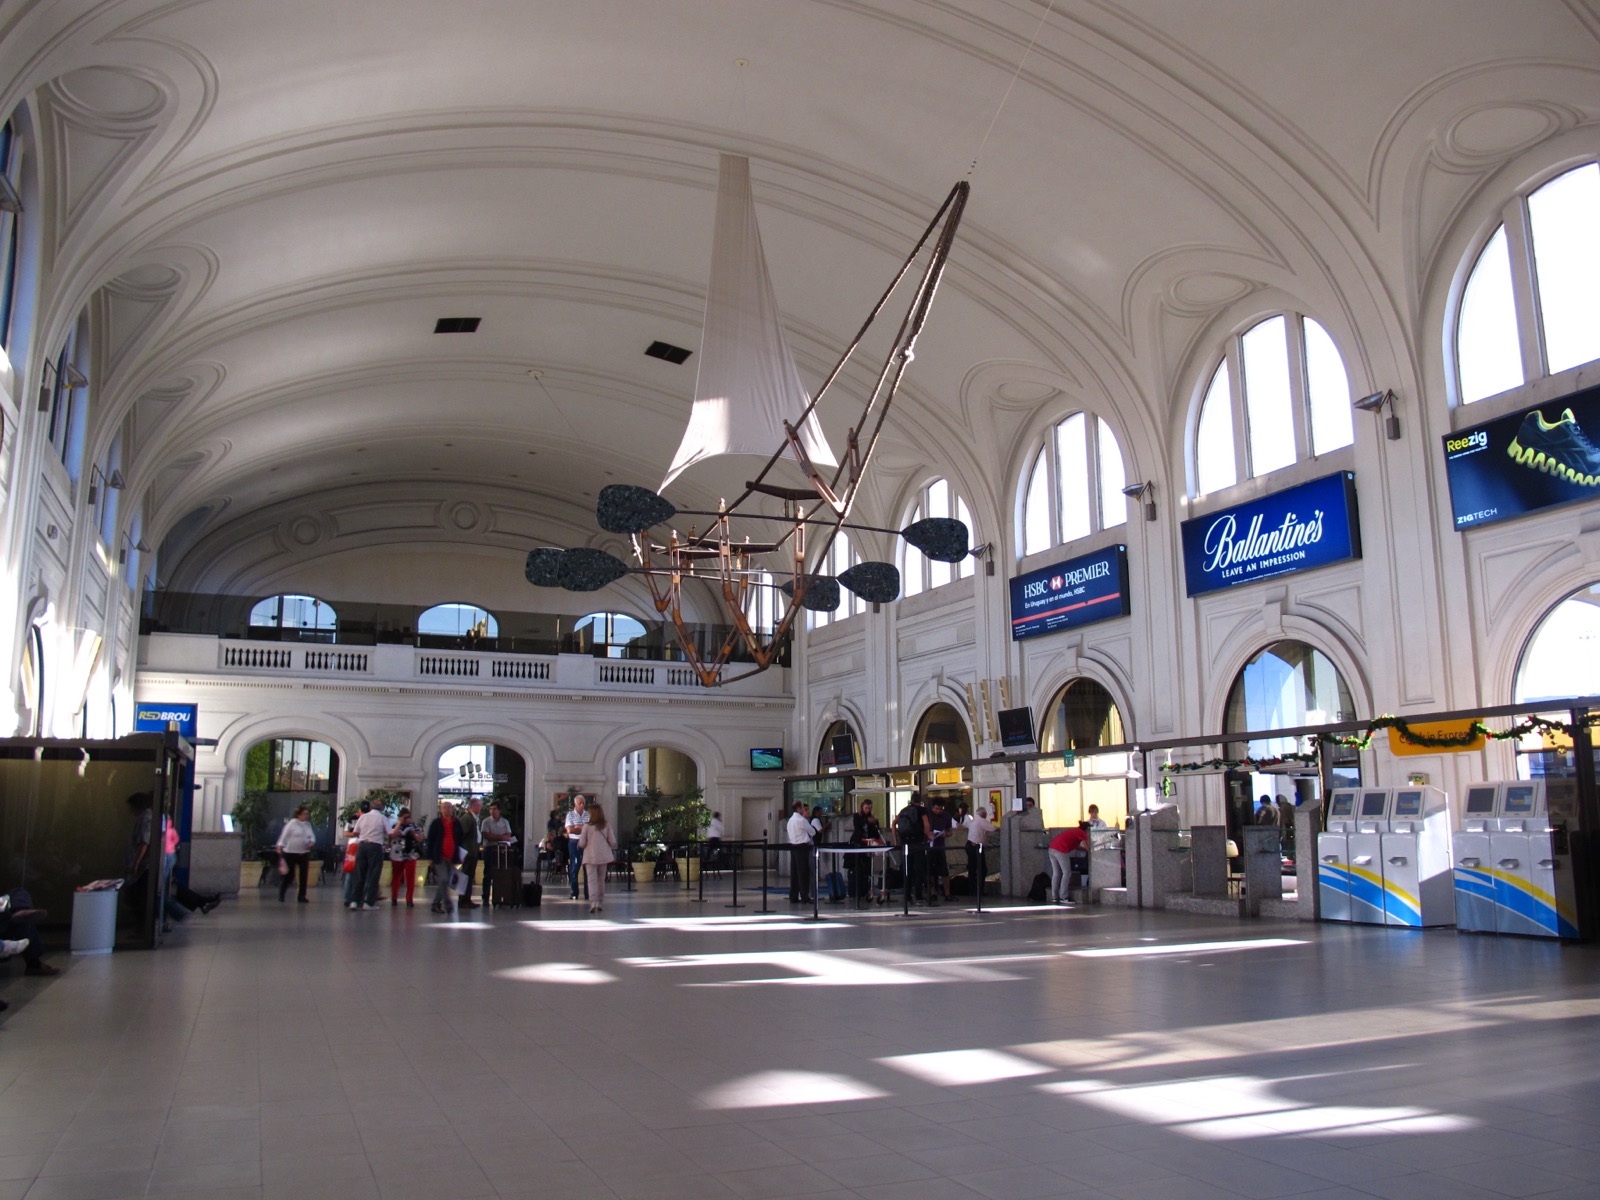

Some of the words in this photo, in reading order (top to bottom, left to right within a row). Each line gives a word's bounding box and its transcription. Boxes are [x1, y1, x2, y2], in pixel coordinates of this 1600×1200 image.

[1447, 432, 1487, 452] Reezig
[1457, 508, 1497, 524] ZIGTECH
[1203, 510, 1324, 572] Ballantine's
[1222, 566, 1243, 578] LEAVE
[1246, 563, 1257, 573] AN
[1260, 550, 1305, 569] IMPRESSION
[1024, 580, 1048, 598] HSBC
[1065, 561, 1110, 587] PREMIER
[1030, 599, 1046, 608] Uruguay
[1073, 586, 1086, 595] HSBC
